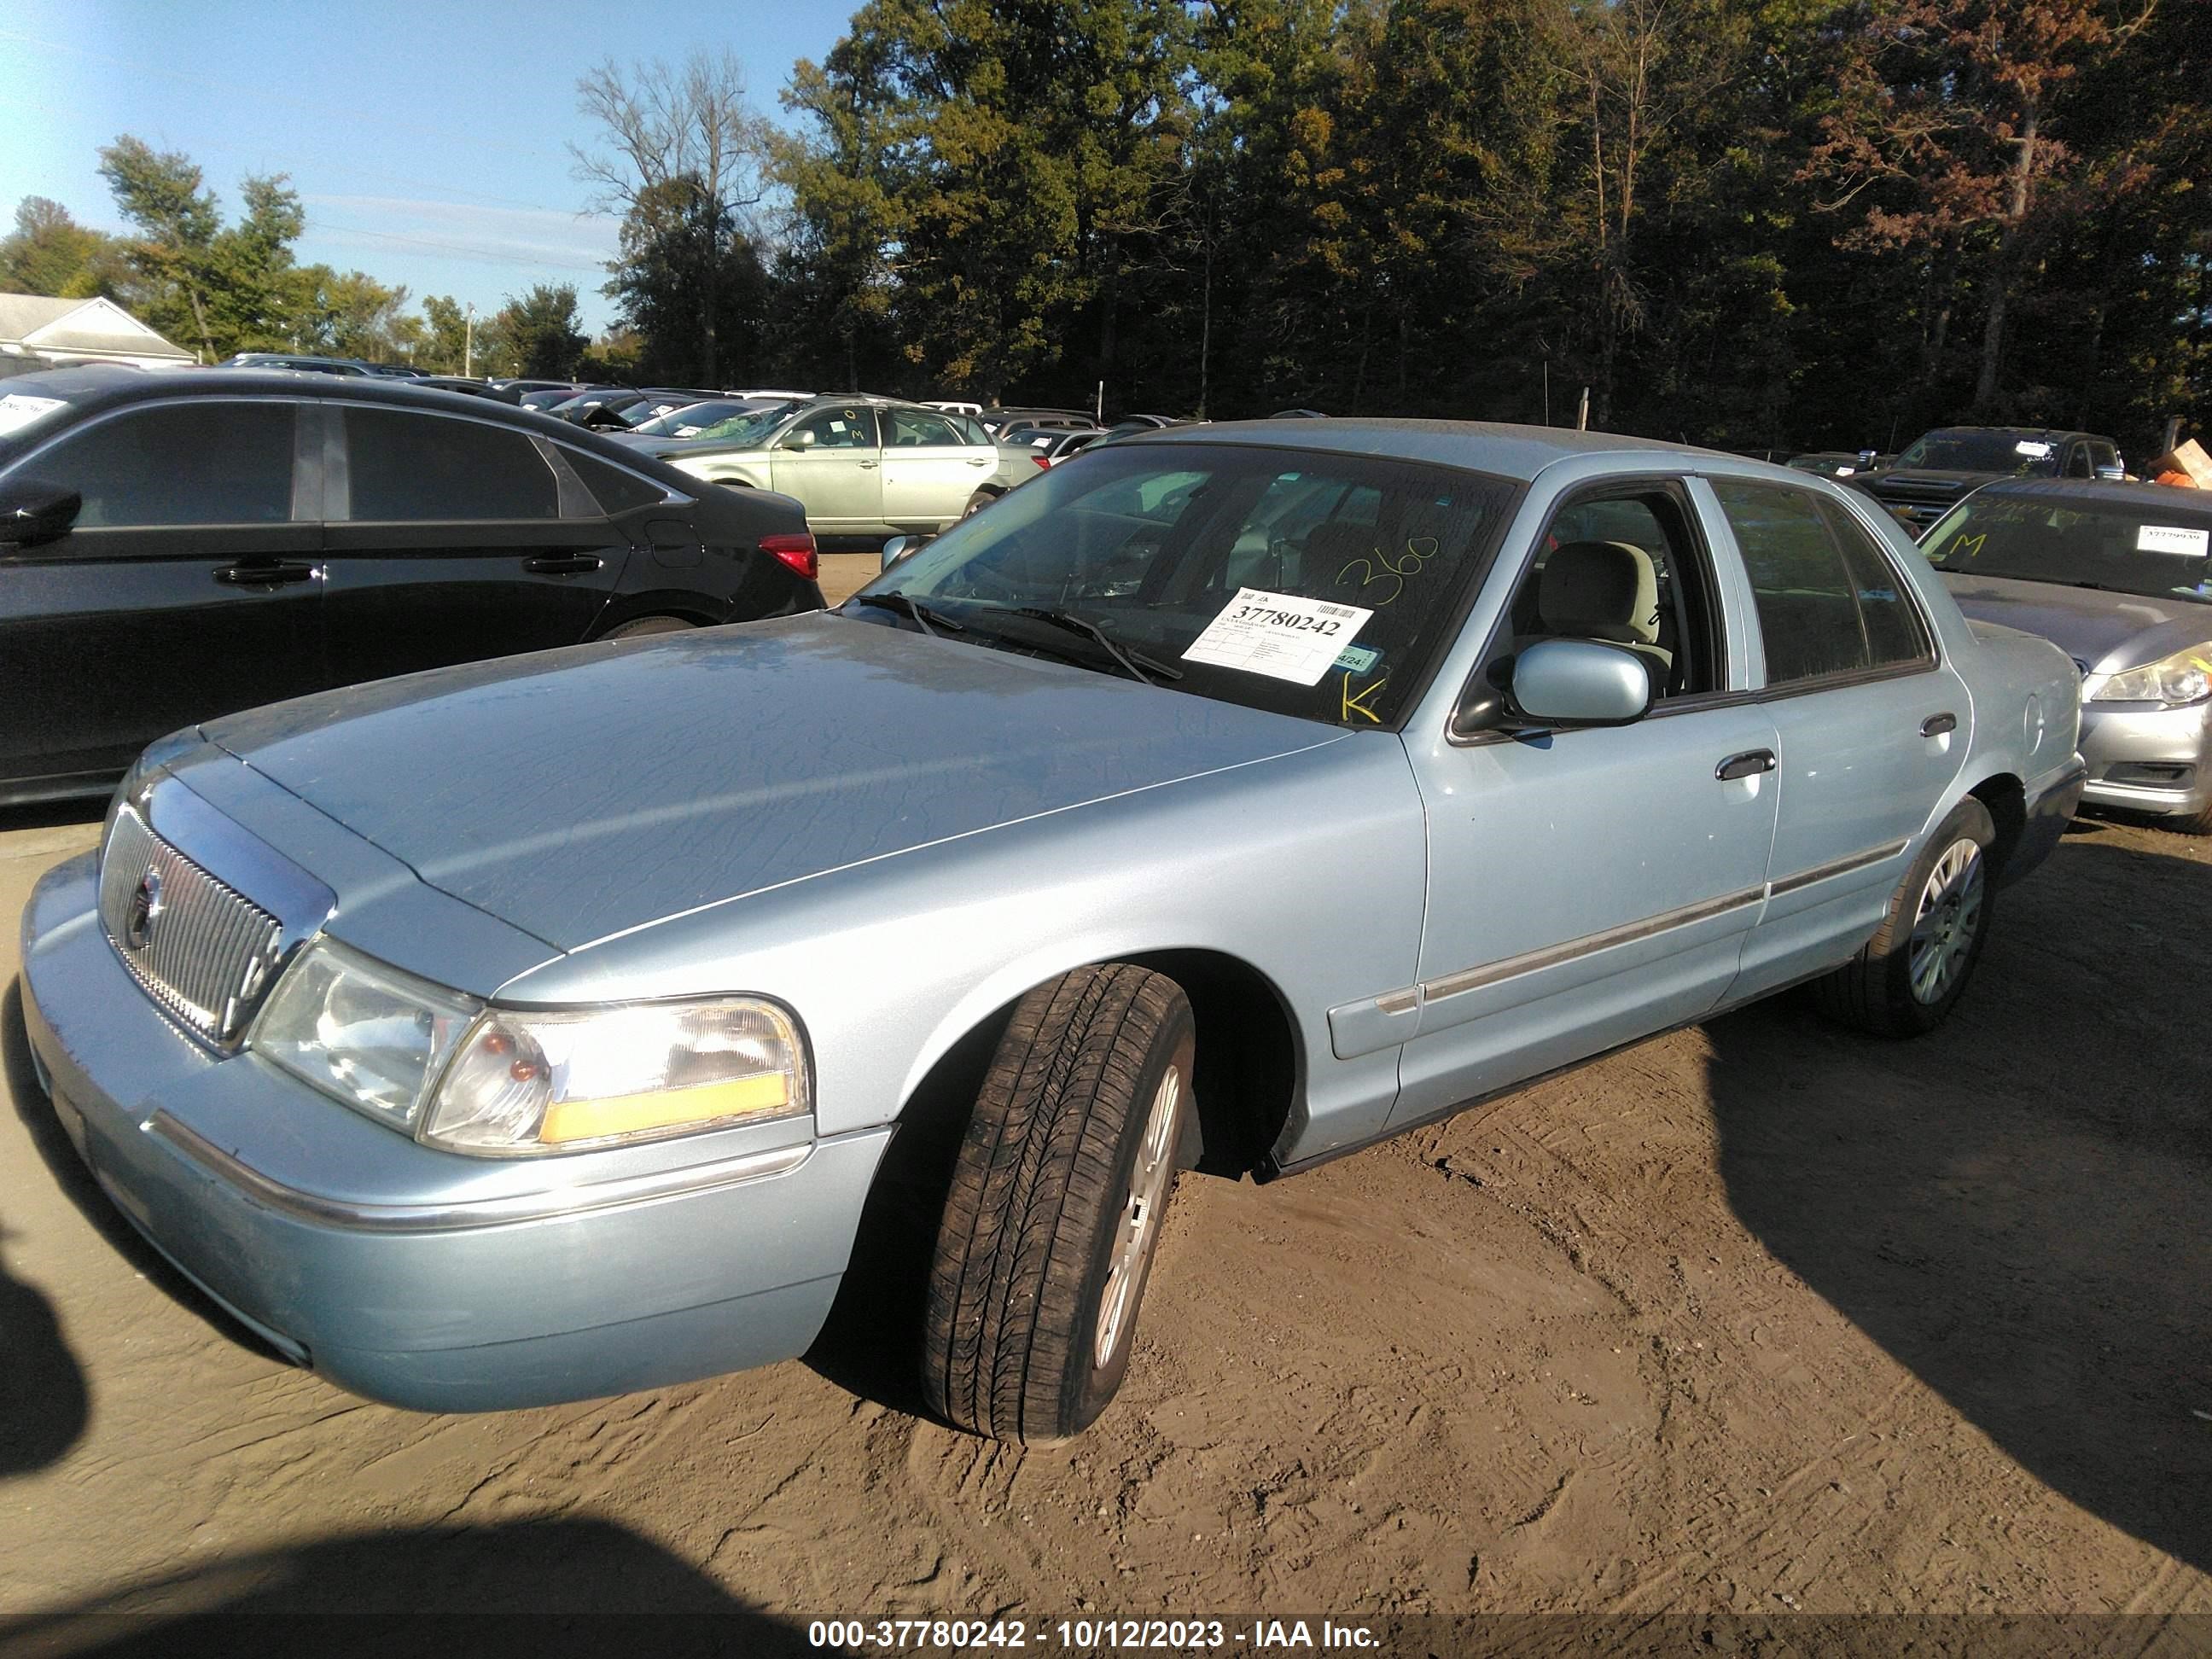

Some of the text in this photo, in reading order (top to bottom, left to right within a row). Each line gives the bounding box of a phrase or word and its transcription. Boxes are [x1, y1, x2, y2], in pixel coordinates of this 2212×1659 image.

[852, 429, 864, 440] M
[1949, 533, 1988, 556] M
[1336, 537, 1439, 606] 360
[1232, 606, 1341, 637] 37780242
[1342, 671, 1387, 724] K
